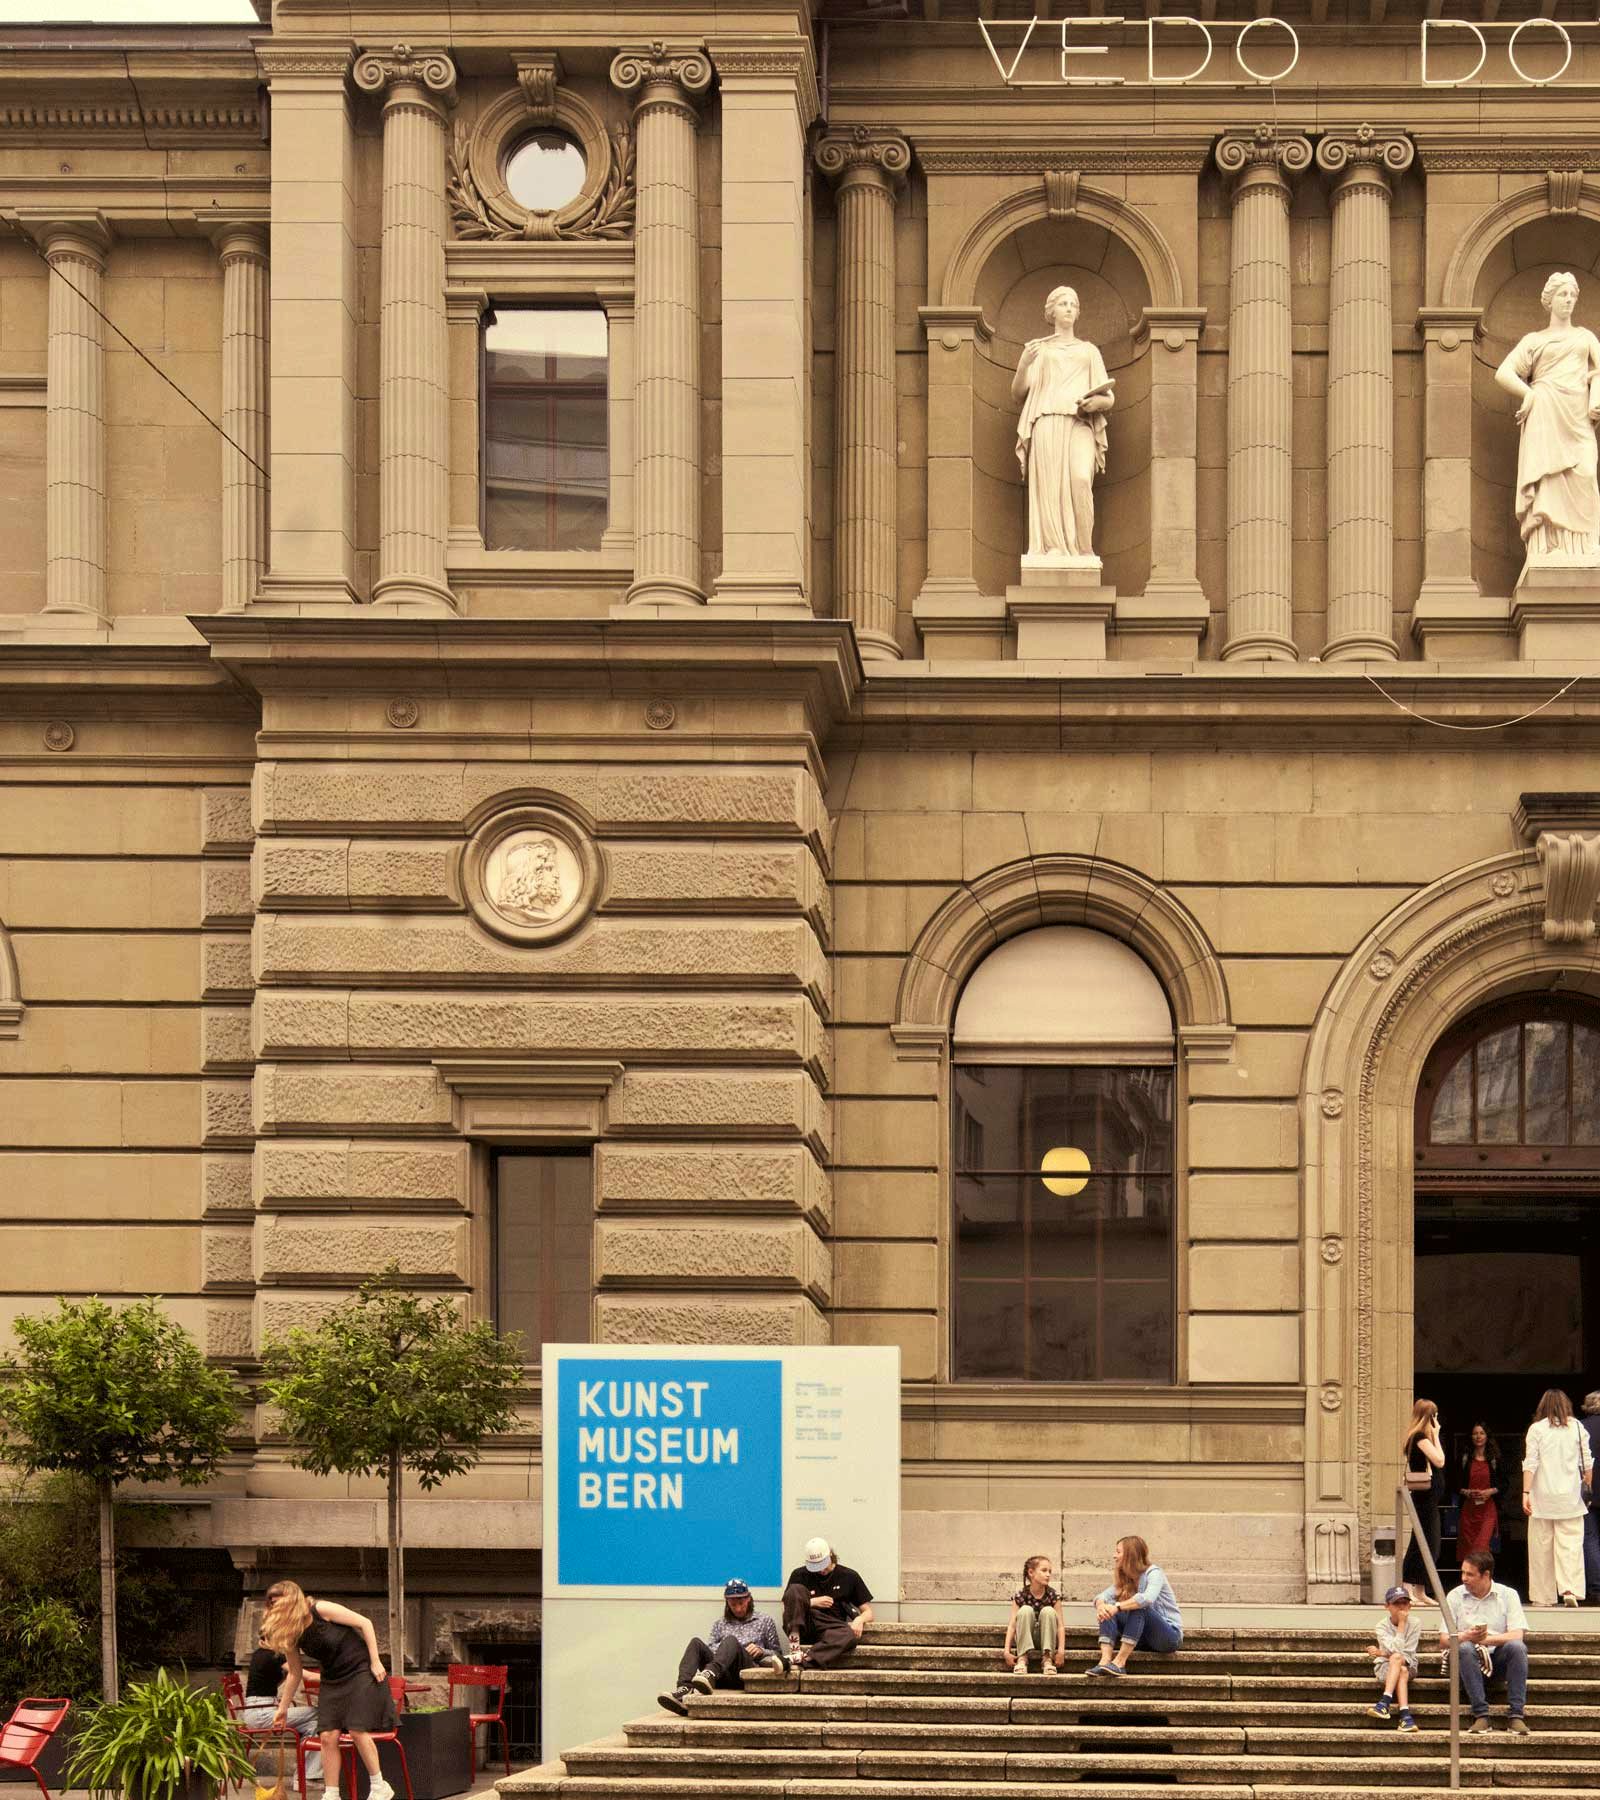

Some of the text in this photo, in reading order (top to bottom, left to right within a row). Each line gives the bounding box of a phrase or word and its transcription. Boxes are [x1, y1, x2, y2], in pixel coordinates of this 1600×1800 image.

[977, 15, 1299, 83] VEDO
[578, 1381, 709, 1417] KUNST
[578, 1427, 739, 1464] MUSEUM
[579, 1473, 683, 1509] BERN
